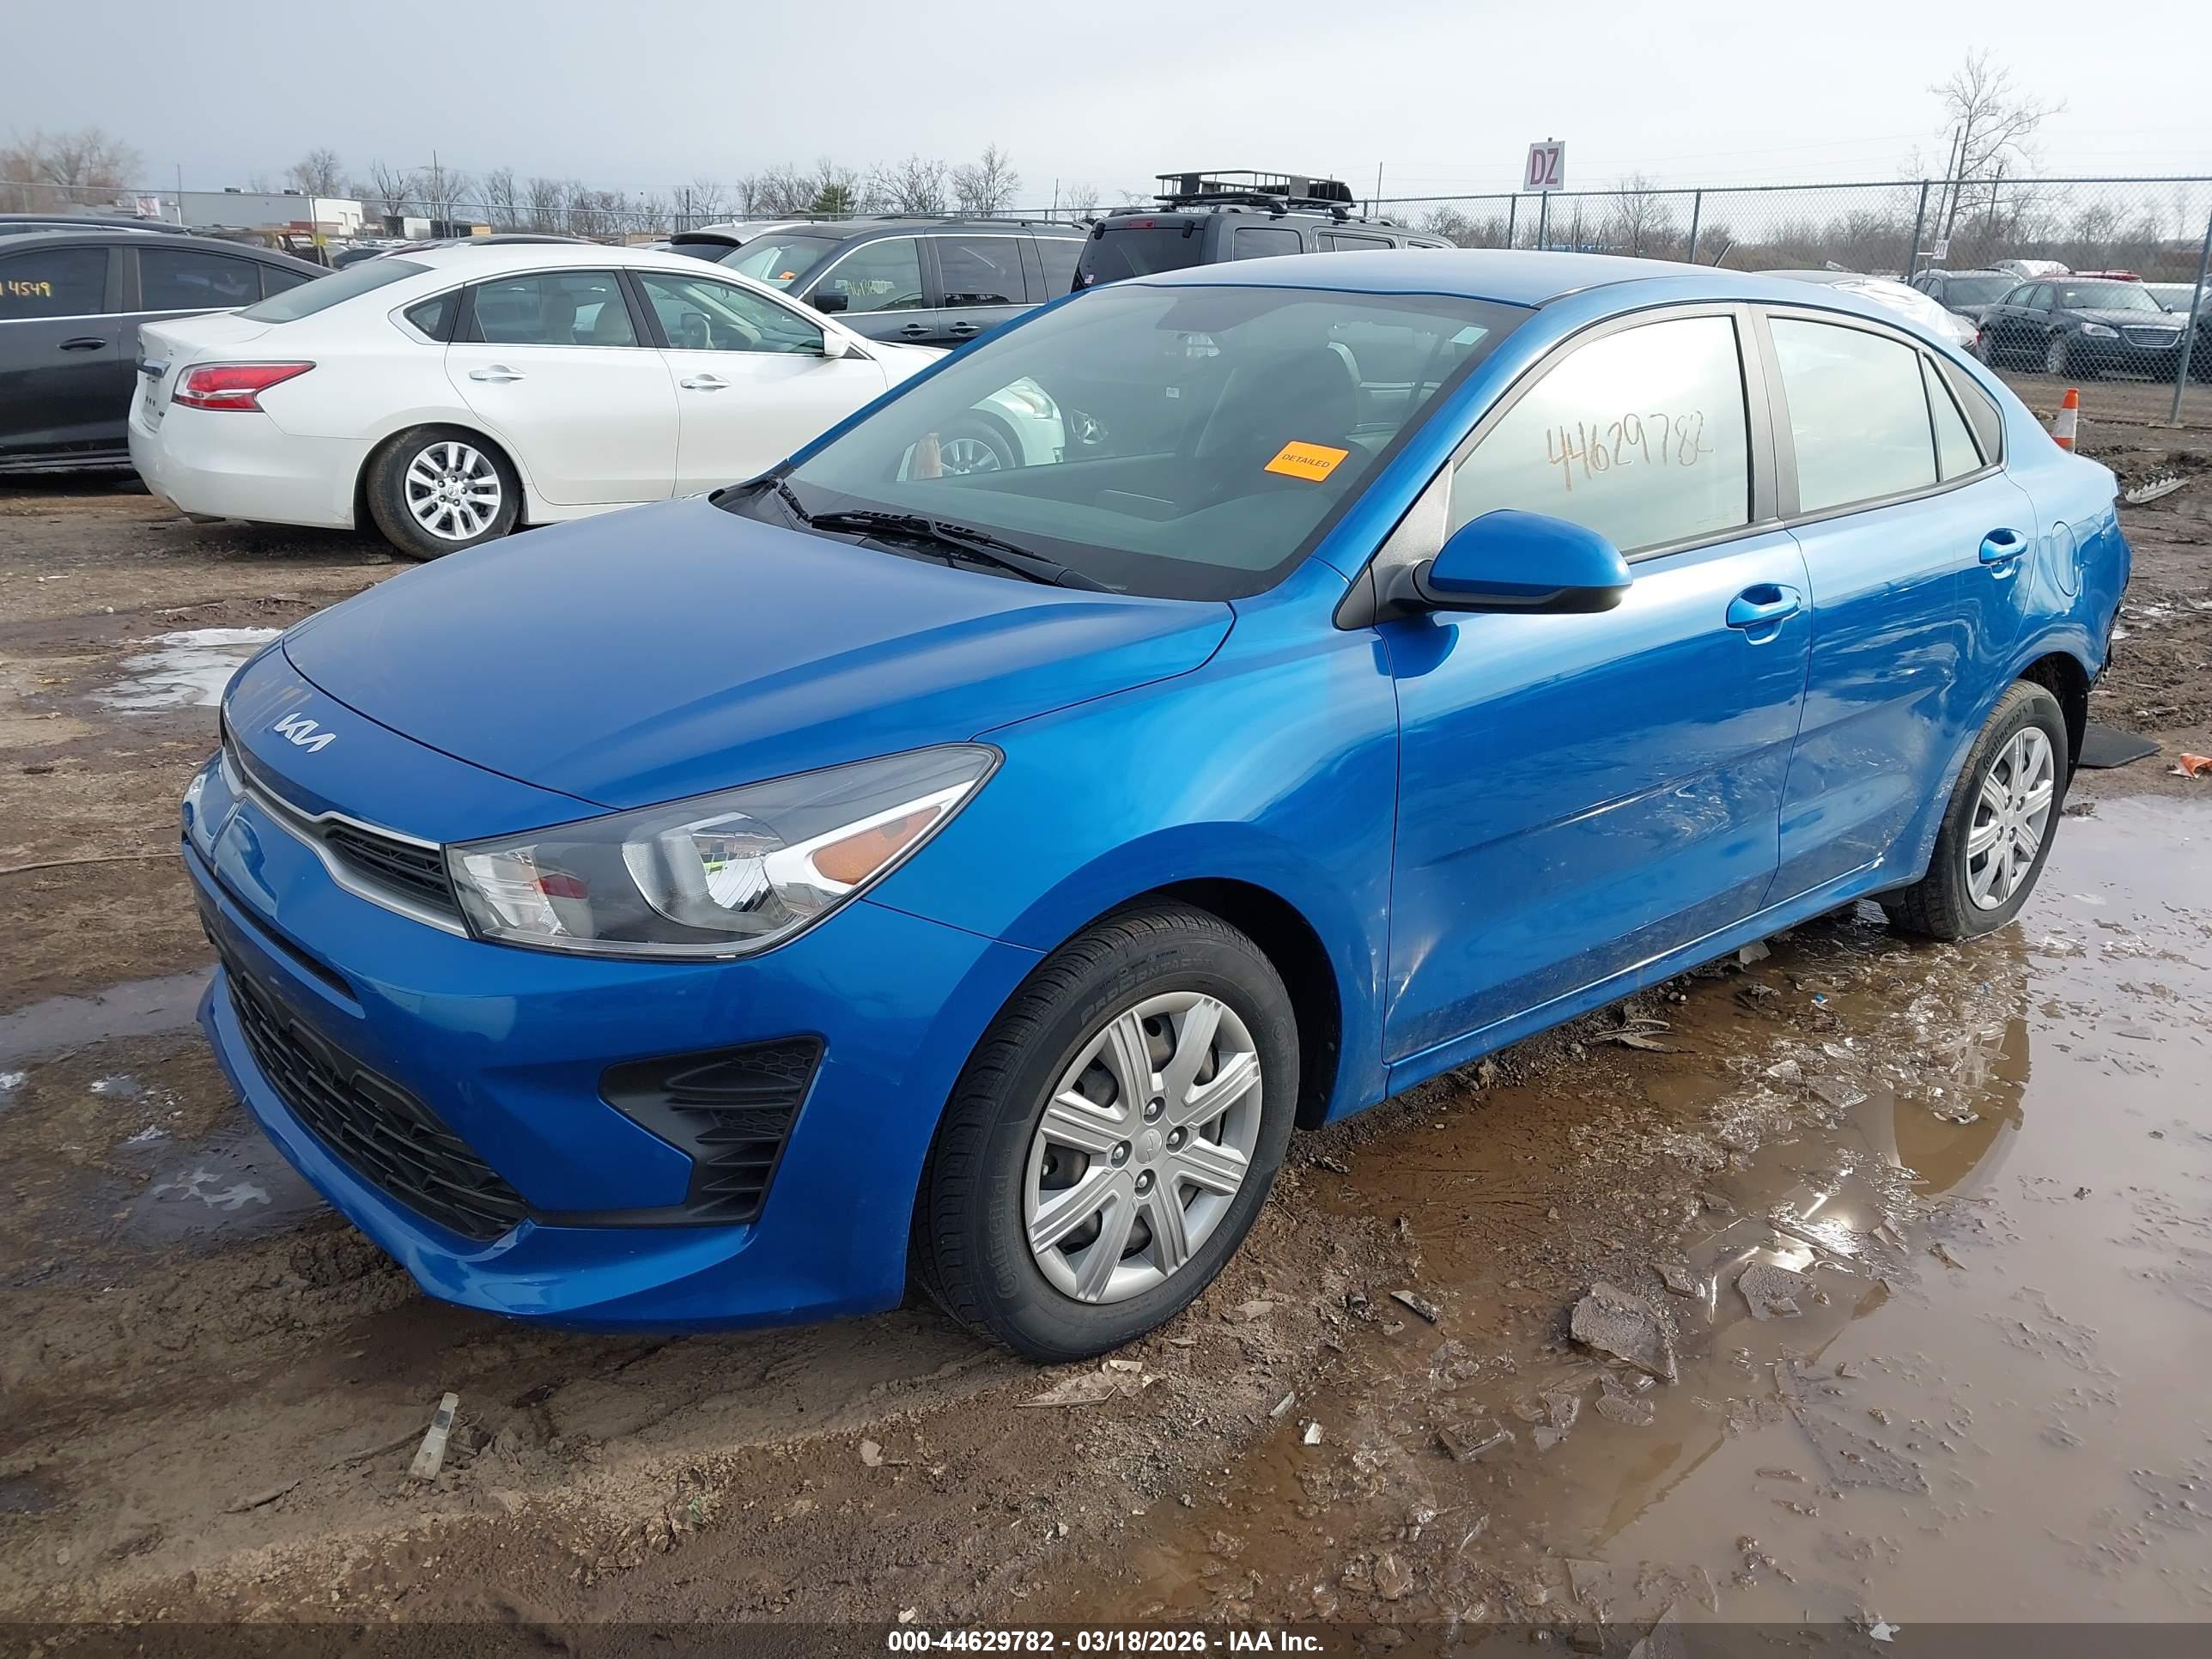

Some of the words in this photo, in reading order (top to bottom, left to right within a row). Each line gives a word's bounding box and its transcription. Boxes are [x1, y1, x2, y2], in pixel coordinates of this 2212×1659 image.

[1530, 148, 1559, 185] DZ
[1281, 453, 1330, 468] DETAILED
[1547, 410, 1716, 491] 44629782
[273, 712, 337, 753] KIA
[1984, 708, 2022, 770] Continental
